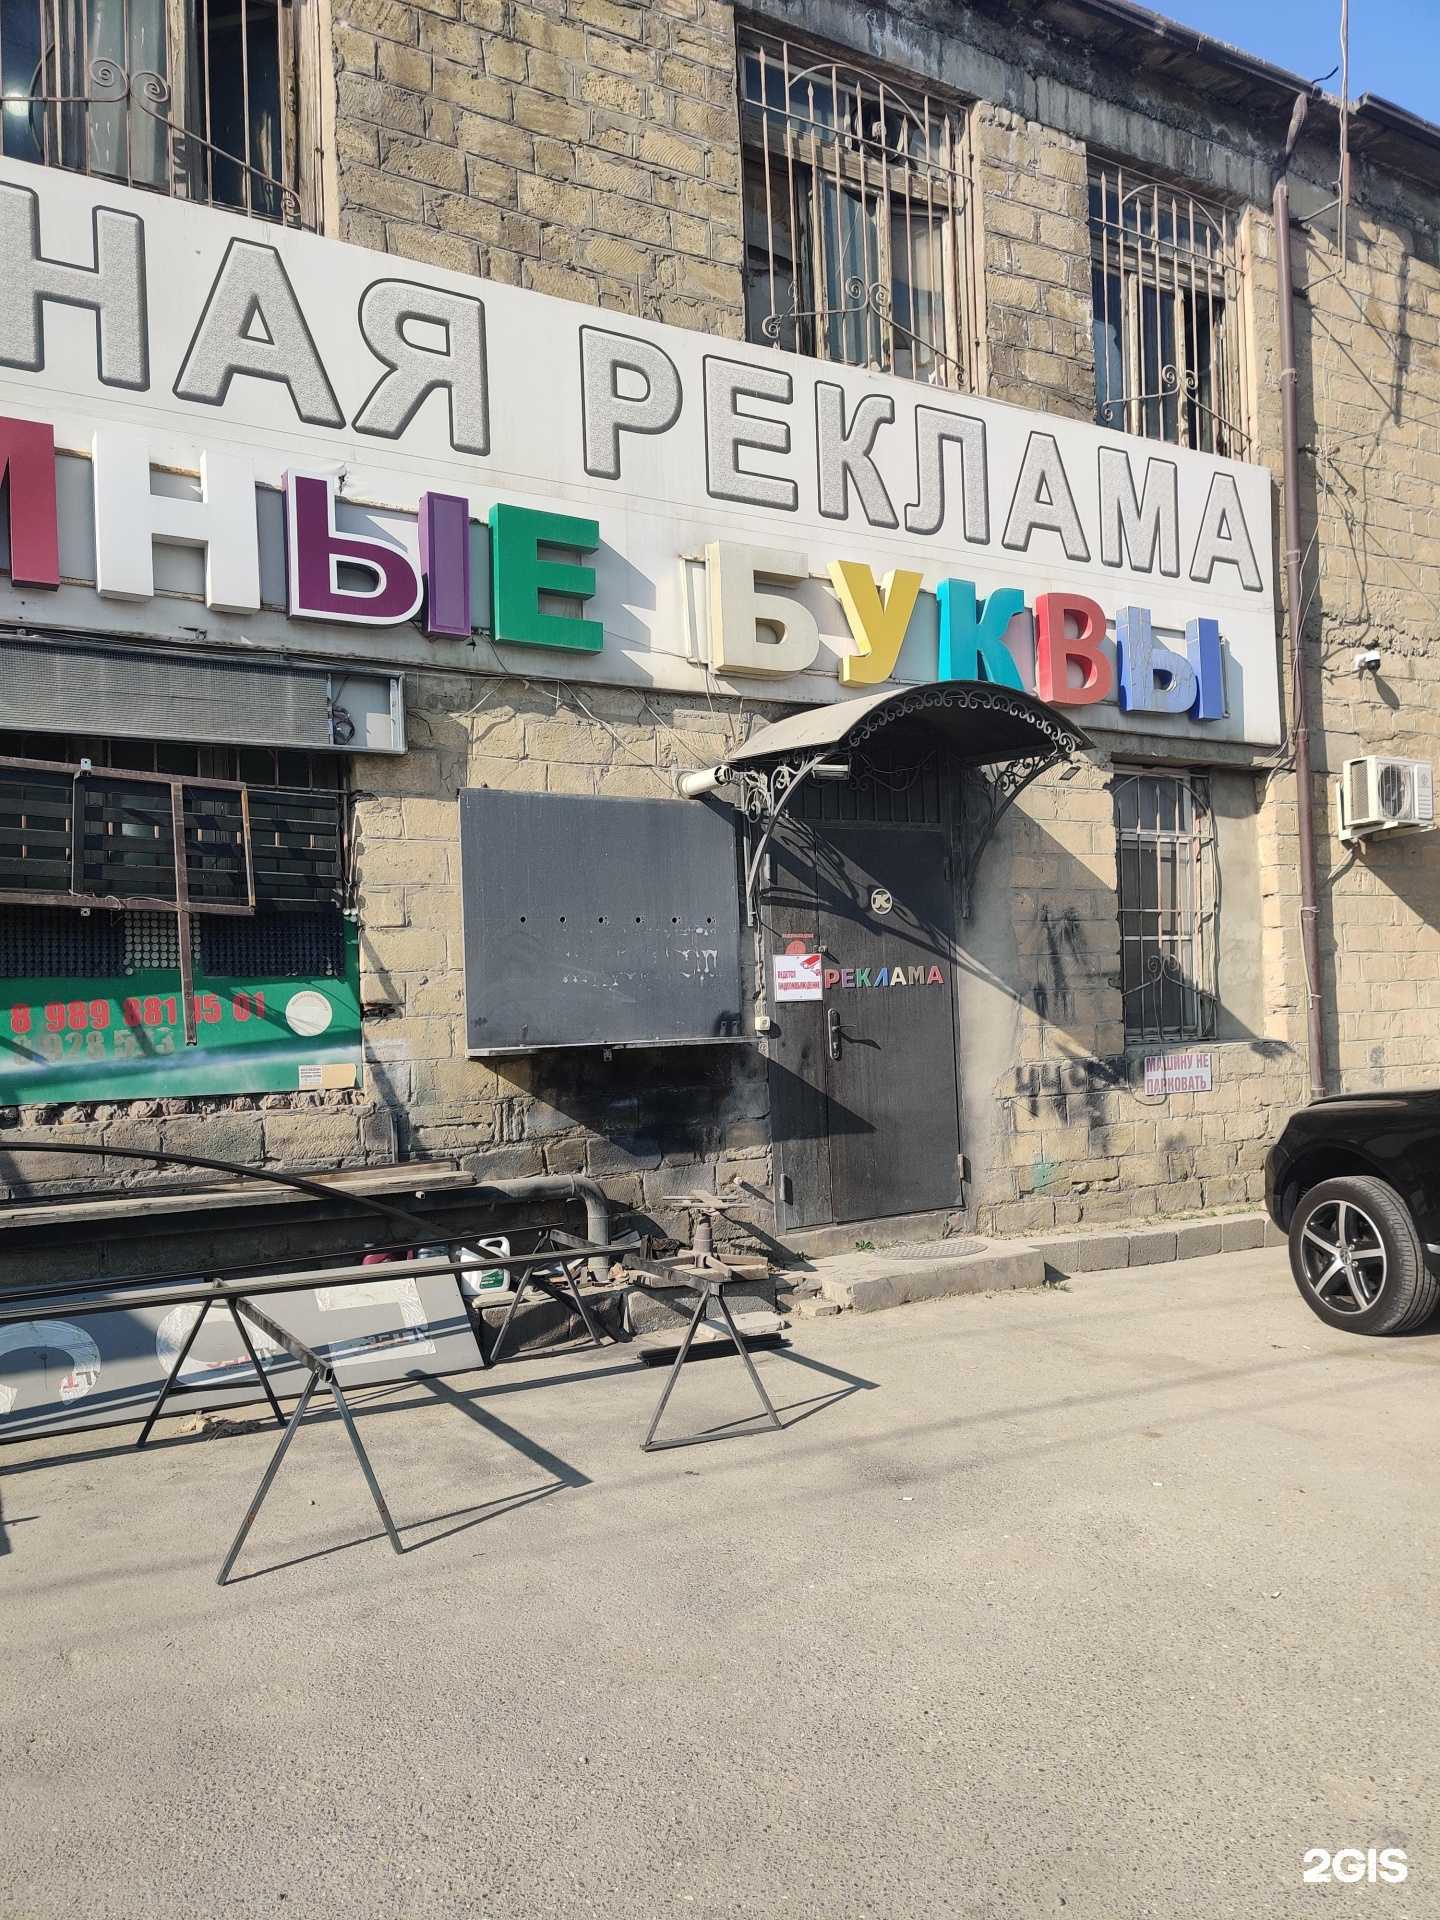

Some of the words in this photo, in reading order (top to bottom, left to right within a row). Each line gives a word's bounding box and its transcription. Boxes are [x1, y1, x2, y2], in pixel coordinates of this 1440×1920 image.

[579, 324, 1264, 592] РЕКЛАМА
[705, 540, 1223, 721] БУКВЫ
[824, 965, 944, 989] РЕКЛАМА
[11, 1003, 31, 1034] 8
[45, 999, 110, 1032] 989
[1147, 1055, 1193, 1072] МАШИНУ
[1197, 1054, 1209, 1068] НЕ
[1147, 1076, 1206, 1093] ПАРКОВАТЬ
